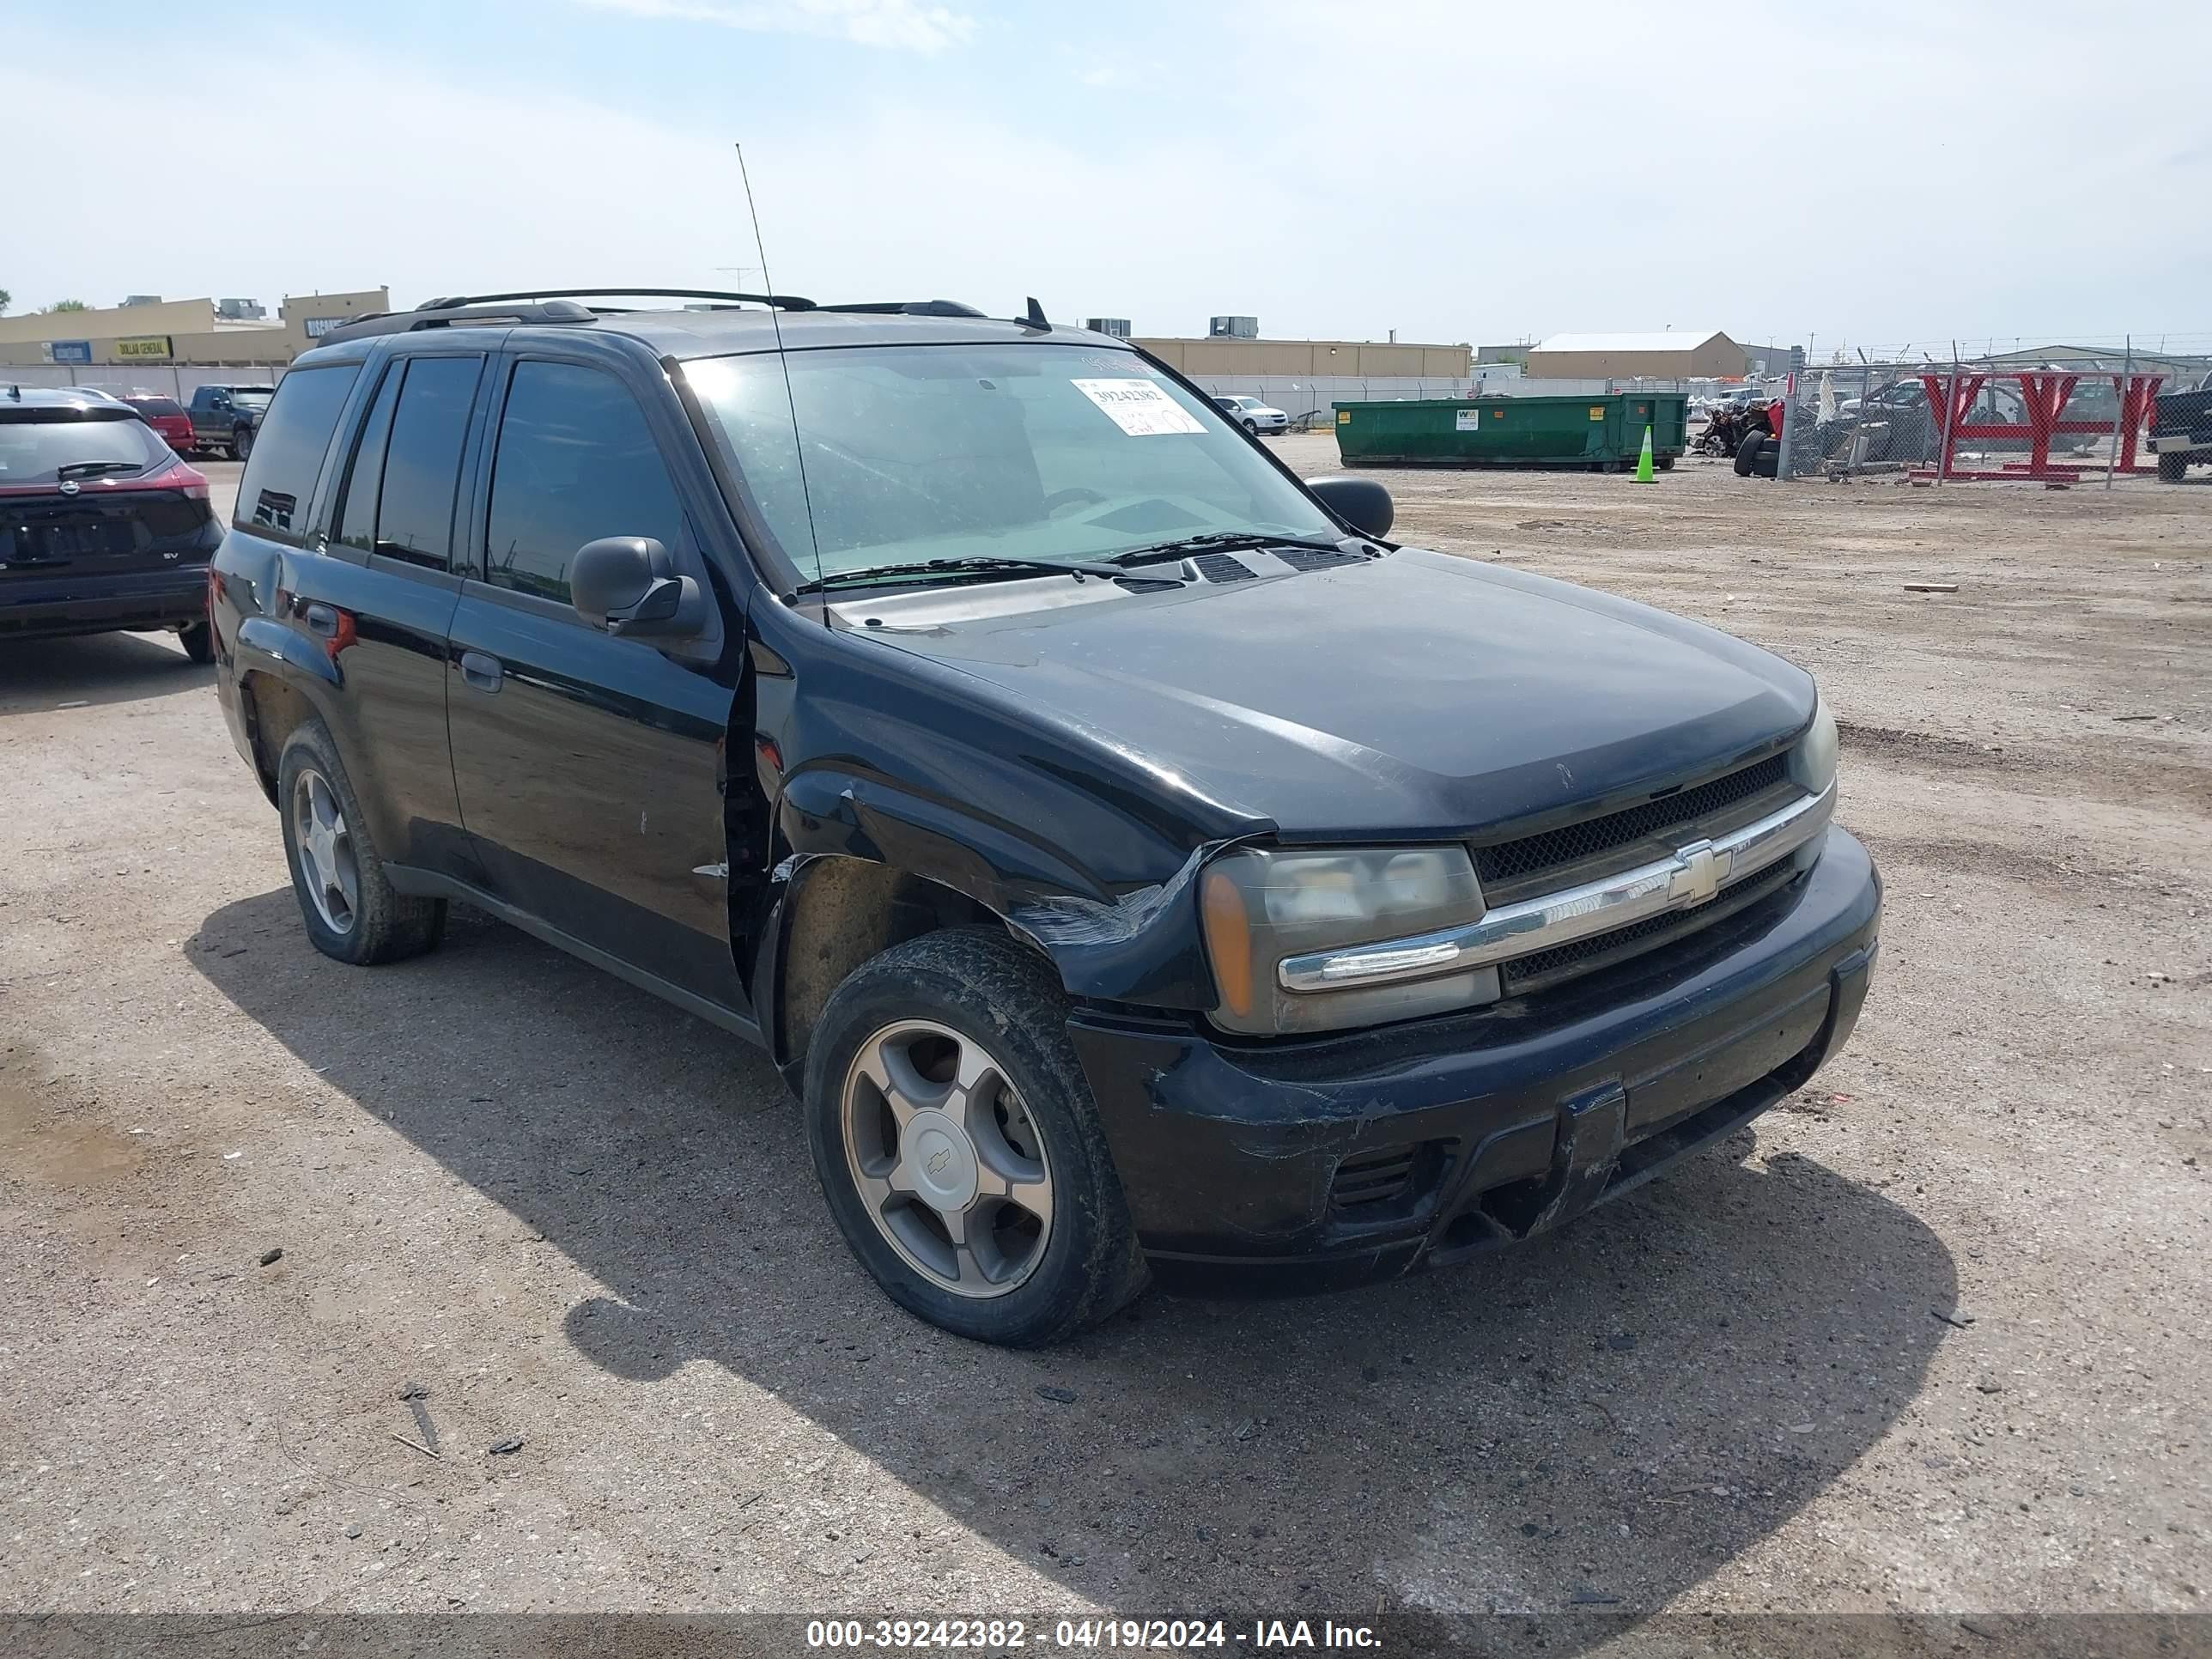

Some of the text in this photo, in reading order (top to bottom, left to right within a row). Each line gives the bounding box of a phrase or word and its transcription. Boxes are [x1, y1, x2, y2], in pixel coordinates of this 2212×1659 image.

[119, 343, 165, 355] DOLLAR GENERAL
[1093, 391, 1163, 403] 39242382
